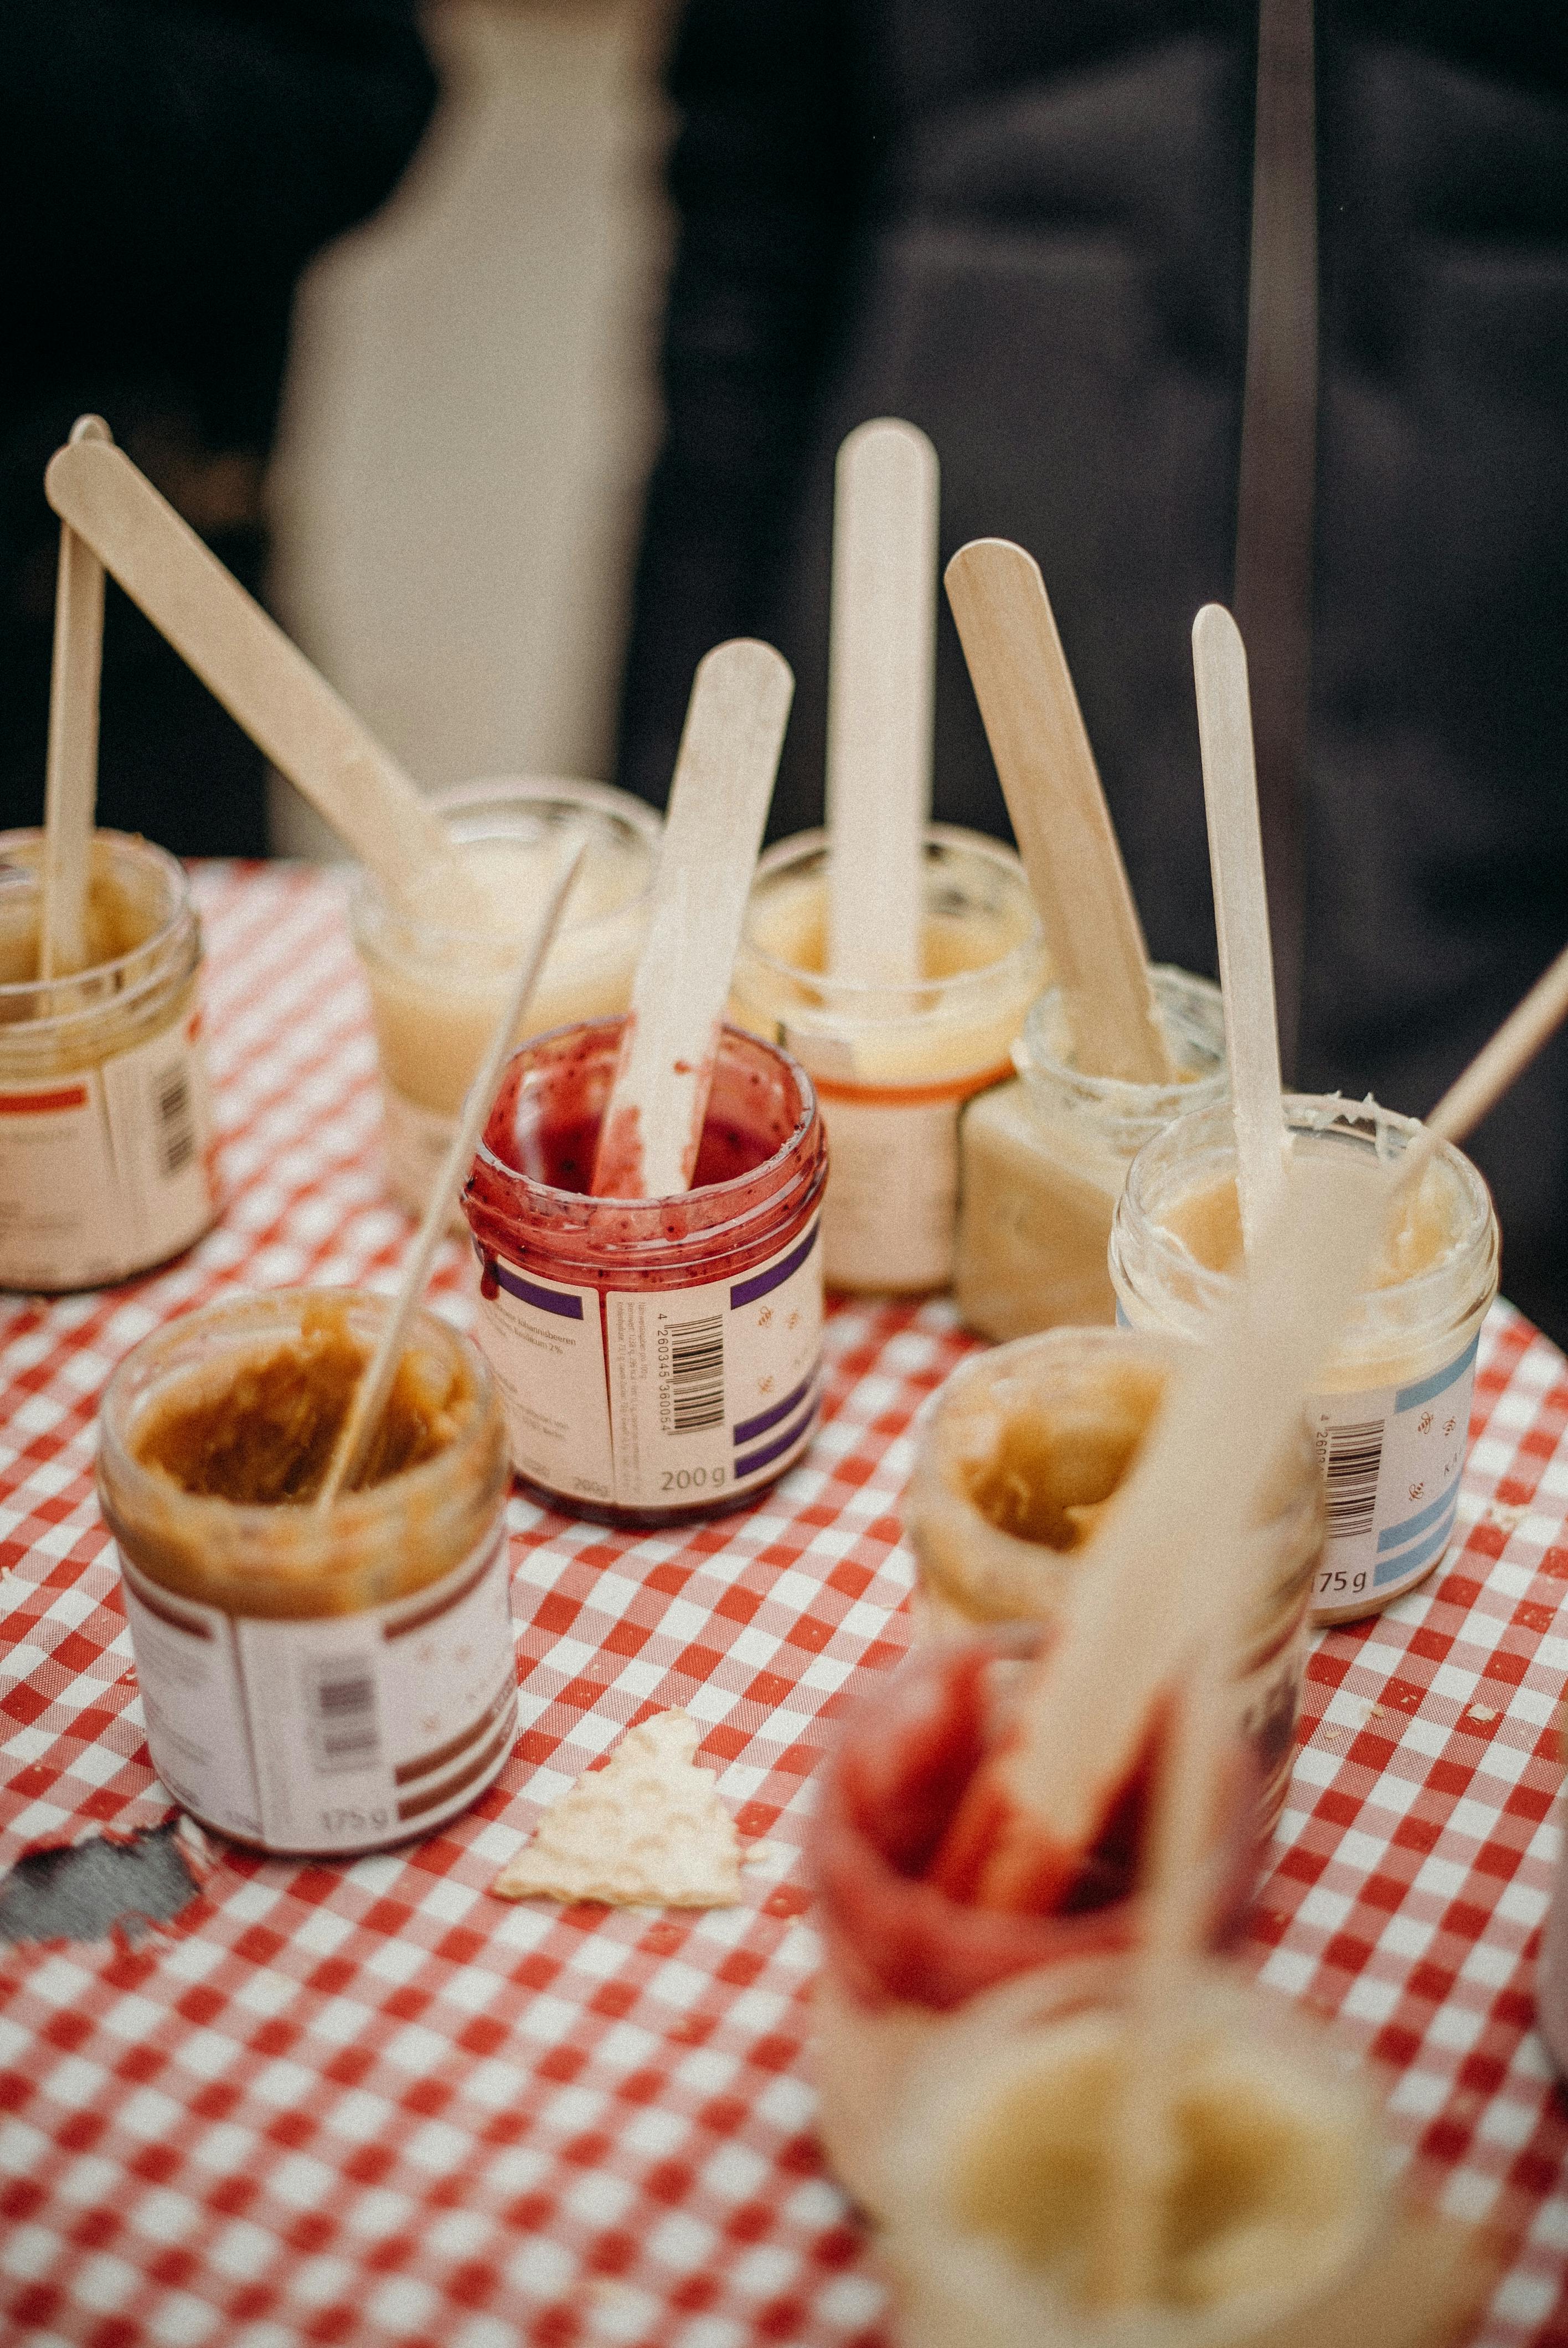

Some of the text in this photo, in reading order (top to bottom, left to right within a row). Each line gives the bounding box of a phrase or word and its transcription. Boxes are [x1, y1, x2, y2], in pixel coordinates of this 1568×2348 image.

[657, 1330, 670, 1378] 260345
[659, 1385, 670, 1432] 360054
[1316, 1430, 1328, 1472] 2603
